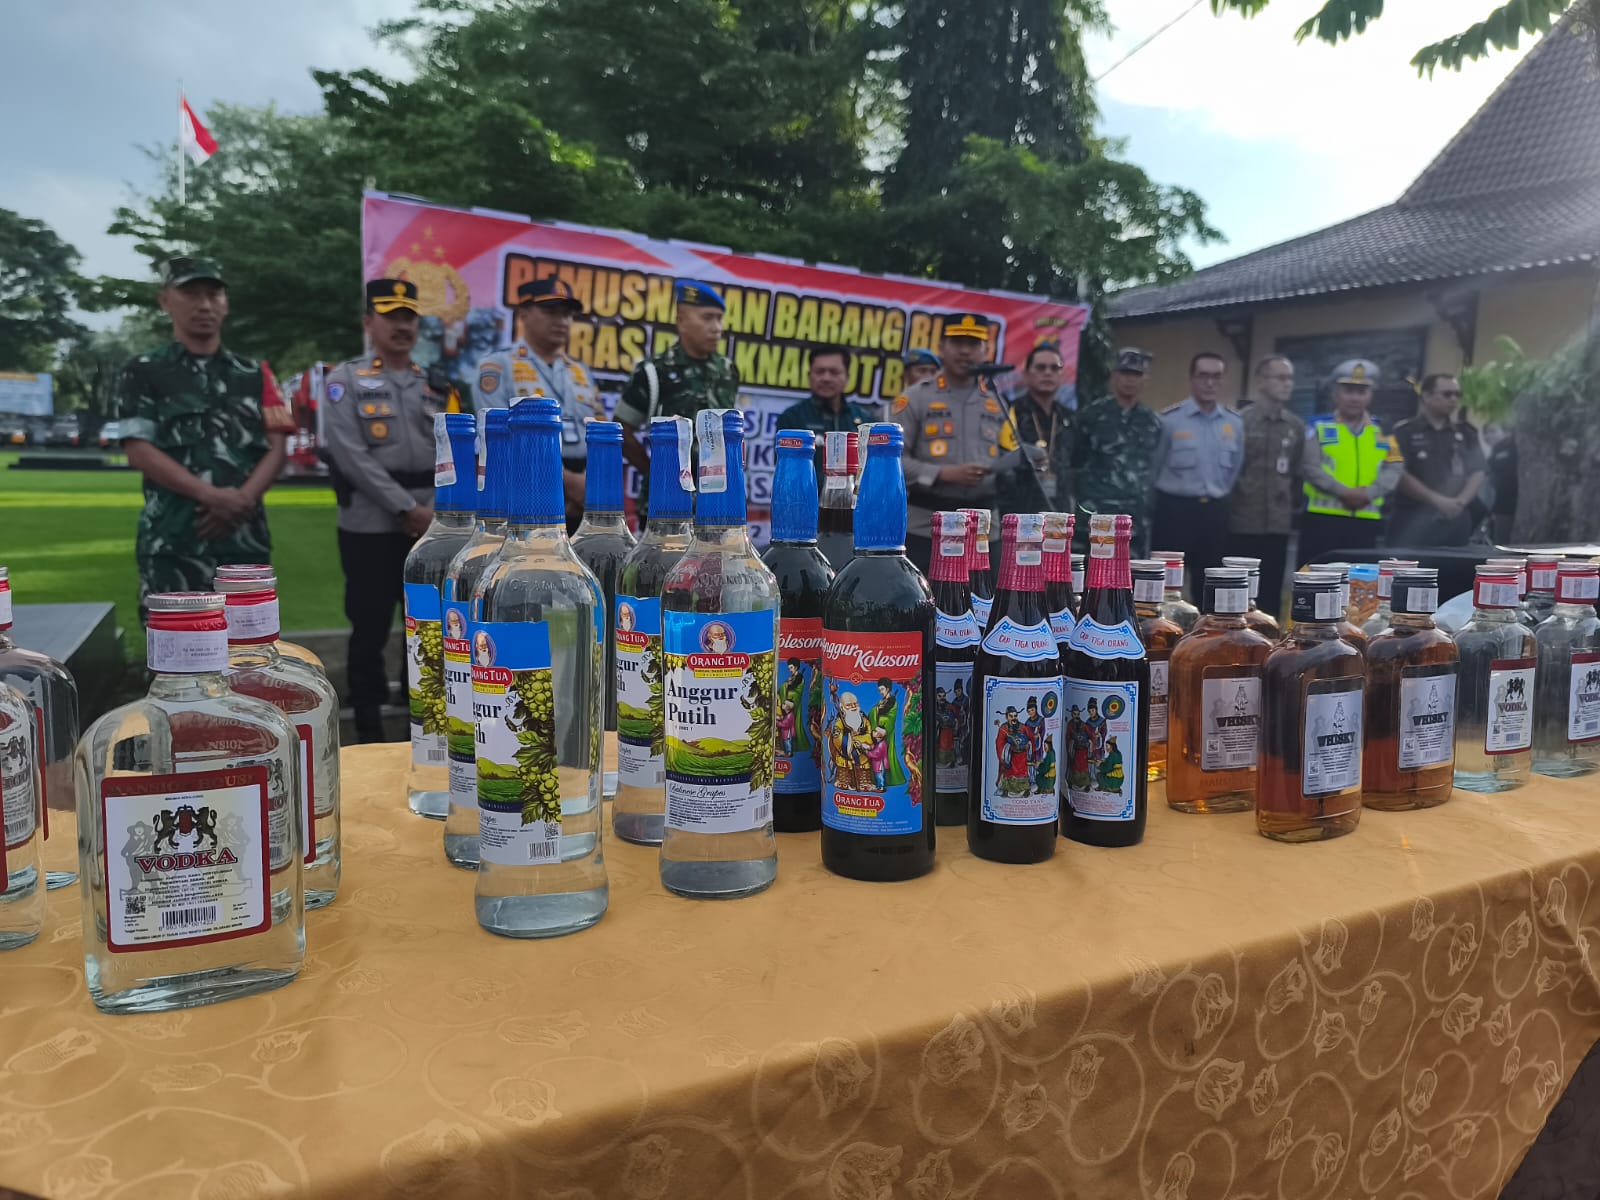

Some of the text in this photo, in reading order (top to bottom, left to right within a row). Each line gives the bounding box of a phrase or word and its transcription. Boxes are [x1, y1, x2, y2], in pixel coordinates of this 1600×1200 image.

[774, 293, 904, 351] BARANG
[779, 634, 822, 649] olesom
[690, 655, 747, 667] ORANG TUA
[853, 649, 920, 672] Kolesom
[489, 670, 509, 681] TUA
[667, 677, 738, 706] Anggur
[668, 702, 717, 725] Putih
[835, 793, 881, 807] ORANG TUA
[134, 846, 239, 875] VODKA
